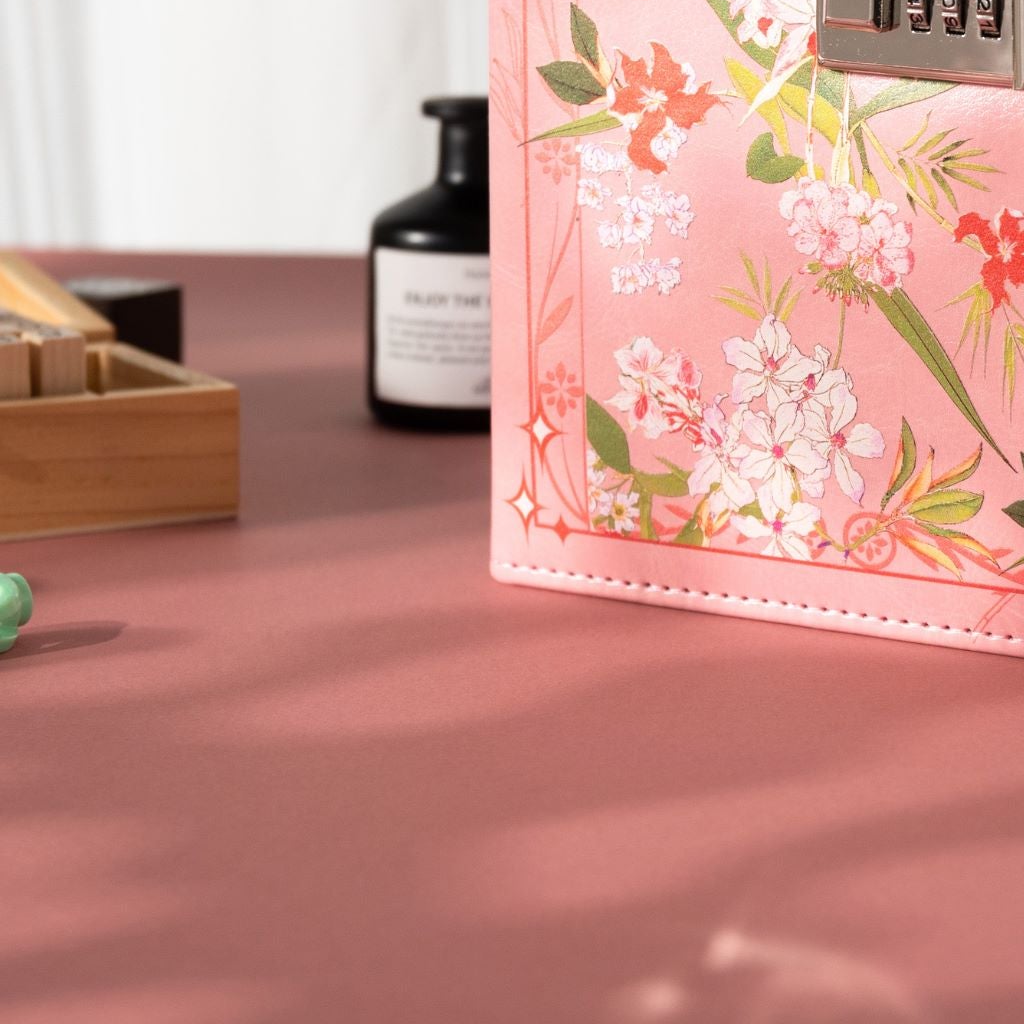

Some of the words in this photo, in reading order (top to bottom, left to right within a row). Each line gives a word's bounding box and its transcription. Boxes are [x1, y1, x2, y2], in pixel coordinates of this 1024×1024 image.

[910, 13, 924, 24] 3
[405, 292, 449, 307] ENJOY
[454, 293, 481, 307] THE
